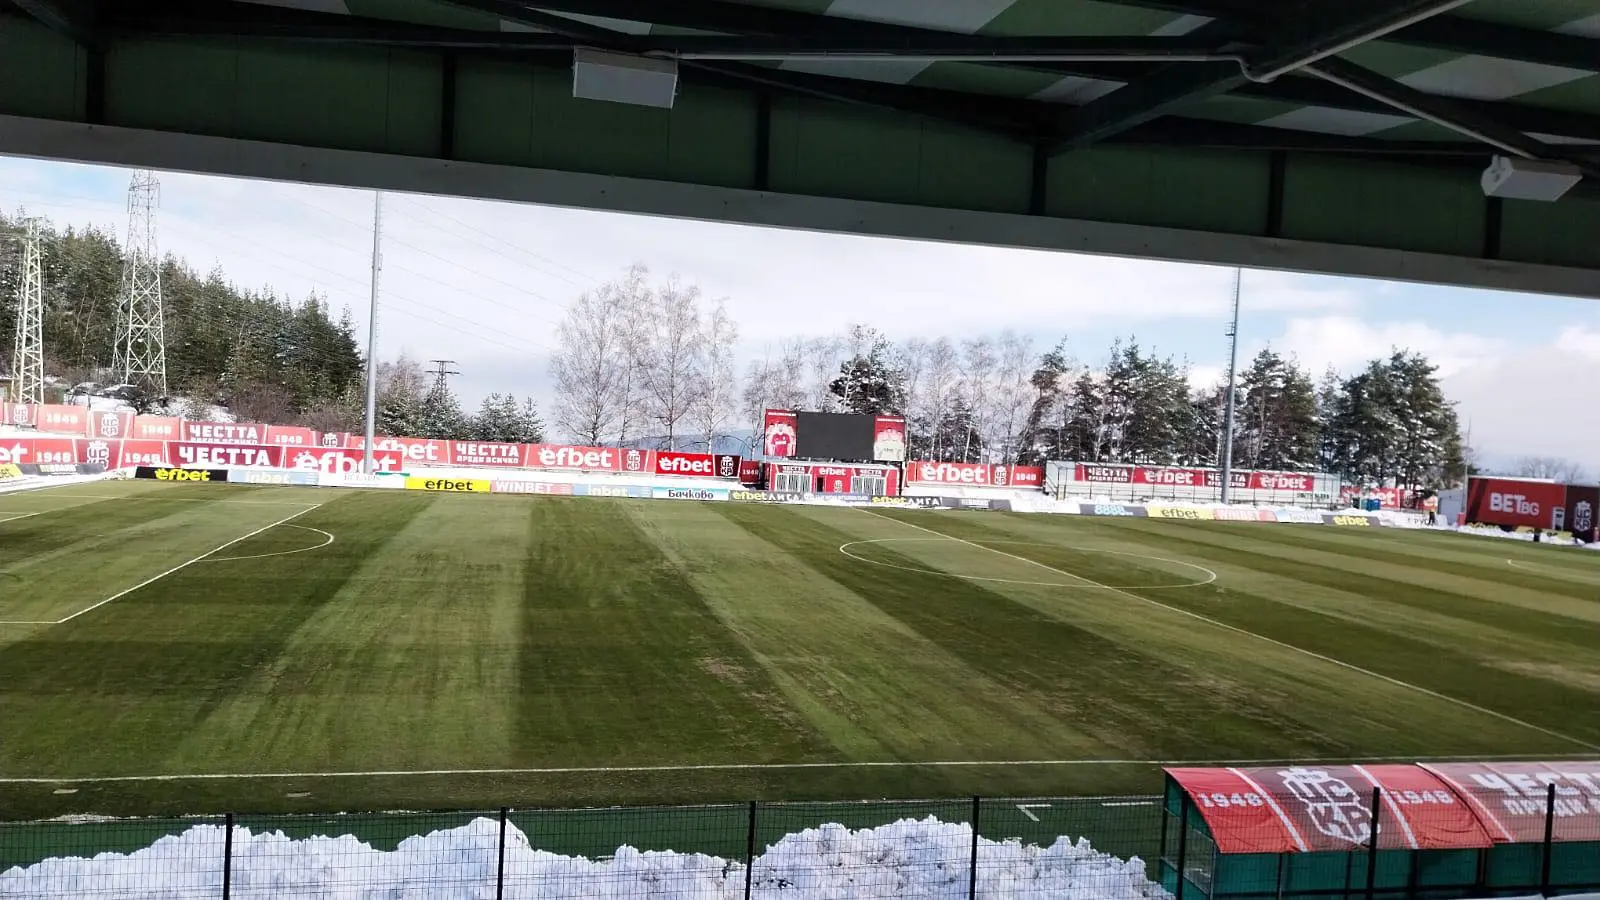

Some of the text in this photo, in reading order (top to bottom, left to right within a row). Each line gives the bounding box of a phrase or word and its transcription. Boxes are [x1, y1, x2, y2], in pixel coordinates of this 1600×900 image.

[190, 424, 258, 439] ЧЕСТТА
[37, 451, 72, 464] 1948
[179, 446, 271, 466] ЧЕСТТА
[456, 443, 519, 457] ЧЕСТТА
[538, 447, 613, 468] efbet
[658, 456, 712, 473] efbet
[155, 468, 211, 481] efbet
[920, 463, 986, 483] efbet
[1144, 470, 1194, 485] efbet
[425, 479, 473, 491] efbet
[495, 480, 554, 493] WINBET
[1260, 474, 1306, 489] efbet
[668, 489, 715, 500] Бачково
[1160, 507, 1200, 519] efbet
[1468, 771, 1600, 796] ЧЕСТ
[1198, 791, 1266, 808] 1948
[1396, 789, 1455, 805] 1948
